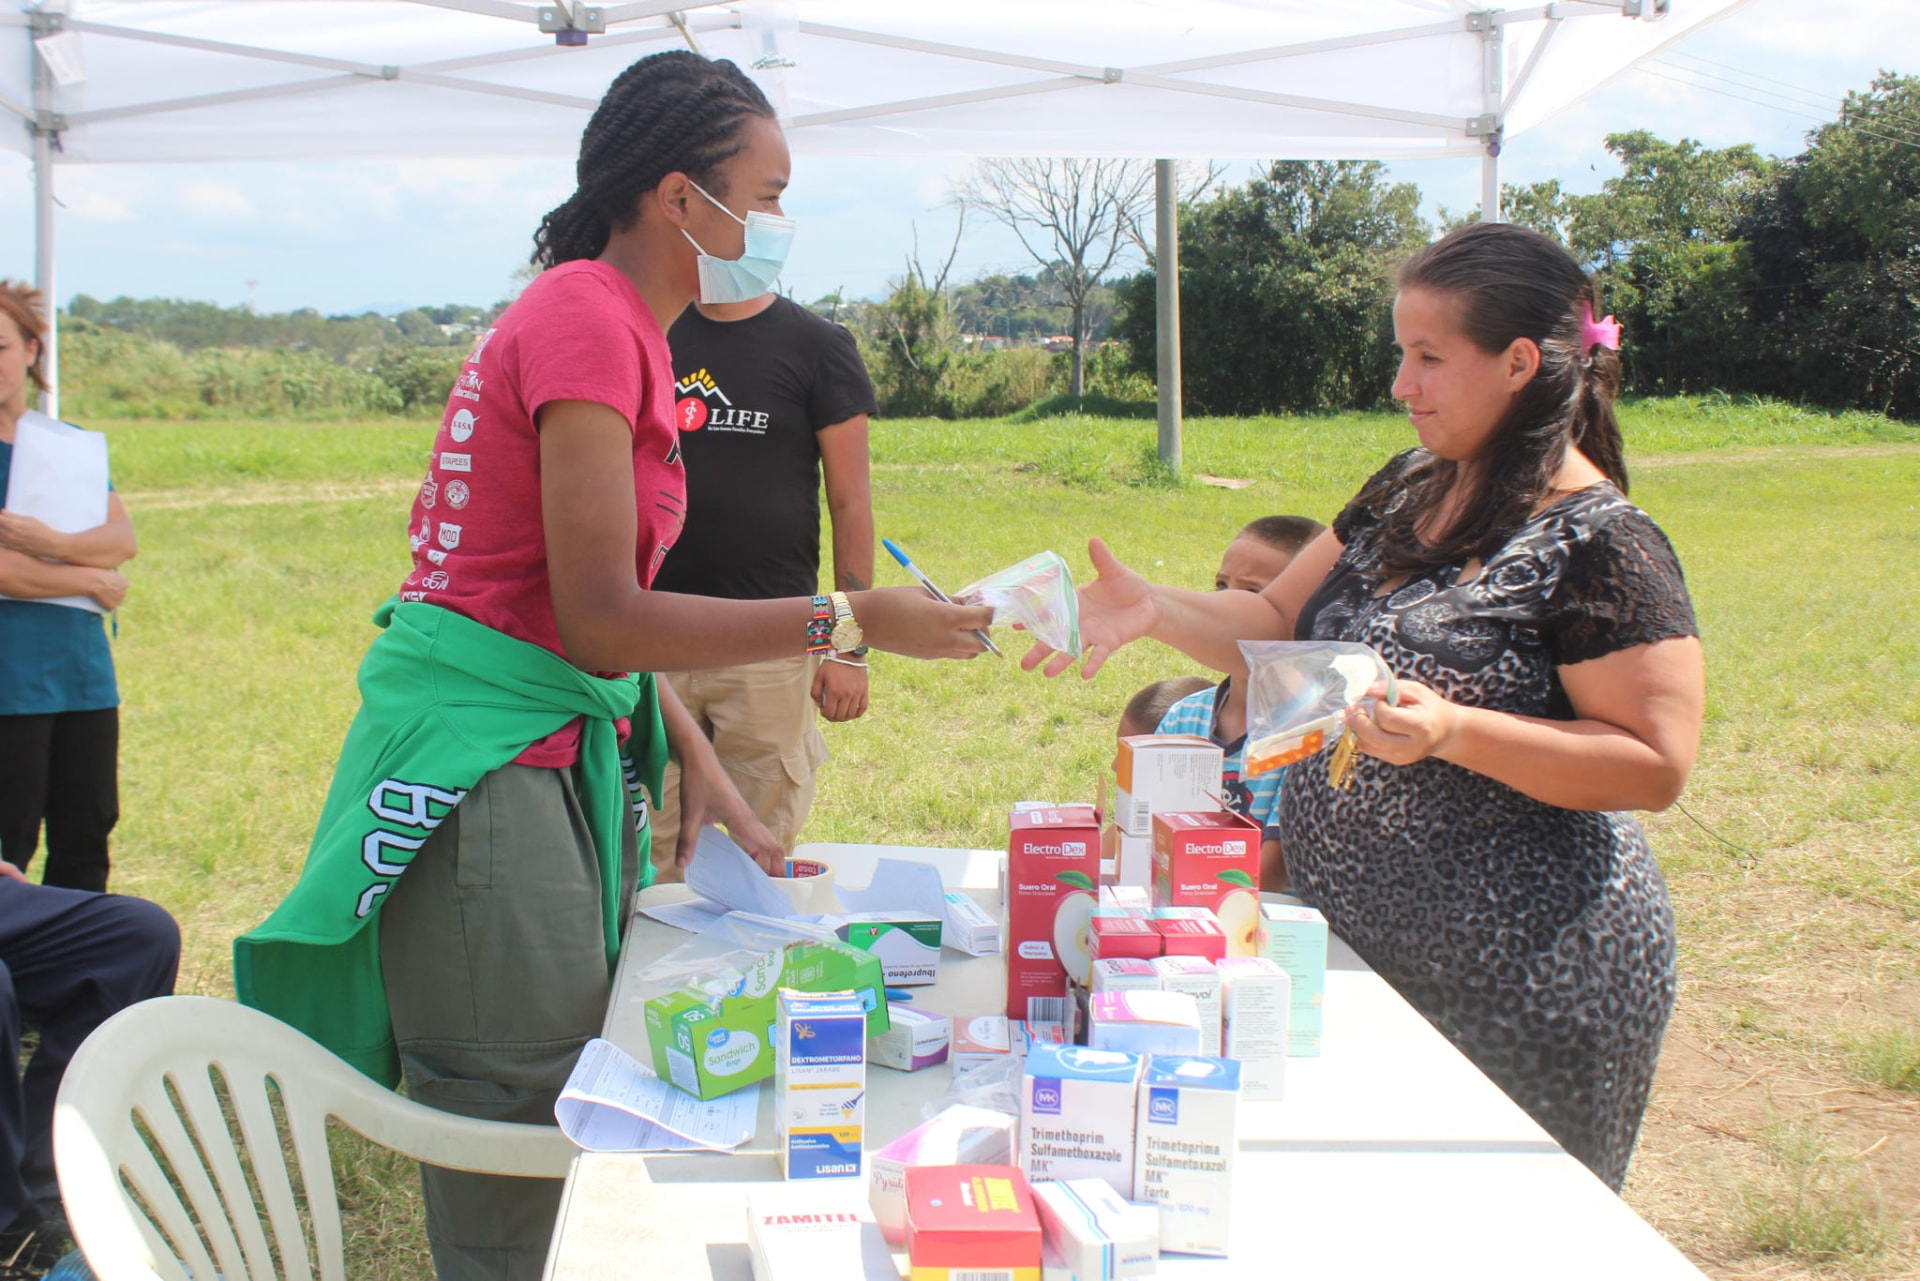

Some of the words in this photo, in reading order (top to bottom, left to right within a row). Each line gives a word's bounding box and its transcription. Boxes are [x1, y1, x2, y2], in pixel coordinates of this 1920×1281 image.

[709, 408, 769, 429] LIFE
[453, 421, 472, 431] NASA
[441, 456, 469, 467] STAPLES
[441, 528, 457, 542] MOD
[1023, 843, 1061, 854] Electro
[1063, 843, 1085, 854] Dex
[1185, 843, 1222, 854] Electro
[1180, 883, 1201, 891] Suero
[888, 968, 936, 979] Ibuprofeno
[708, 1041, 756, 1066] Sandwich
[791, 1055, 862, 1064] DEXTROMETORFANO
[726, 1058, 742, 1067] Bags
[1031, 1127, 1105, 1145] Trimethoprim
[1146, 1136, 1221, 1156] Trimetoprima
[1030, 1143, 1123, 1163] Sulfamethoxazole
[1145, 1153, 1227, 1173] Sulfametoxazol
[1144, 1185, 1170, 1199] Forte
